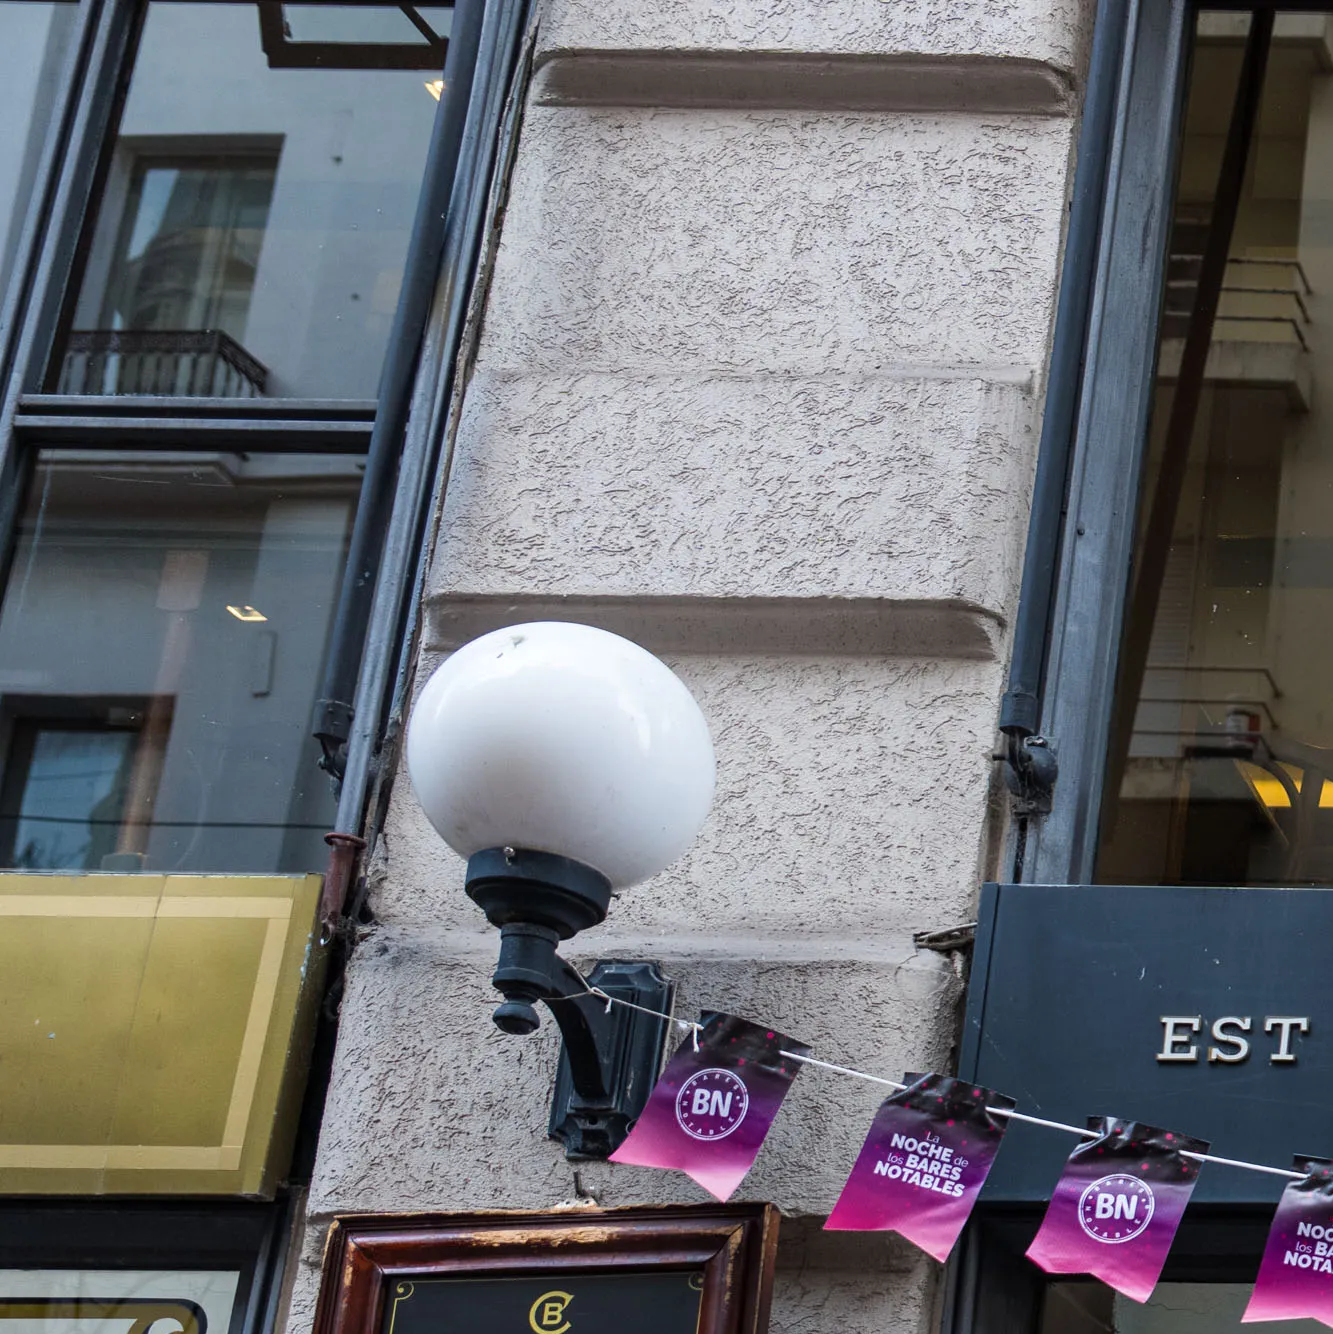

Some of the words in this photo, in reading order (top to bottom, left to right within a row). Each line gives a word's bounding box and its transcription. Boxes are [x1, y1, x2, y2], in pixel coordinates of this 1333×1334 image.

[1156, 1014, 1311, 1069] EST
[691, 1088, 732, 1118] BN
[1095, 1192, 1138, 1220] BN
